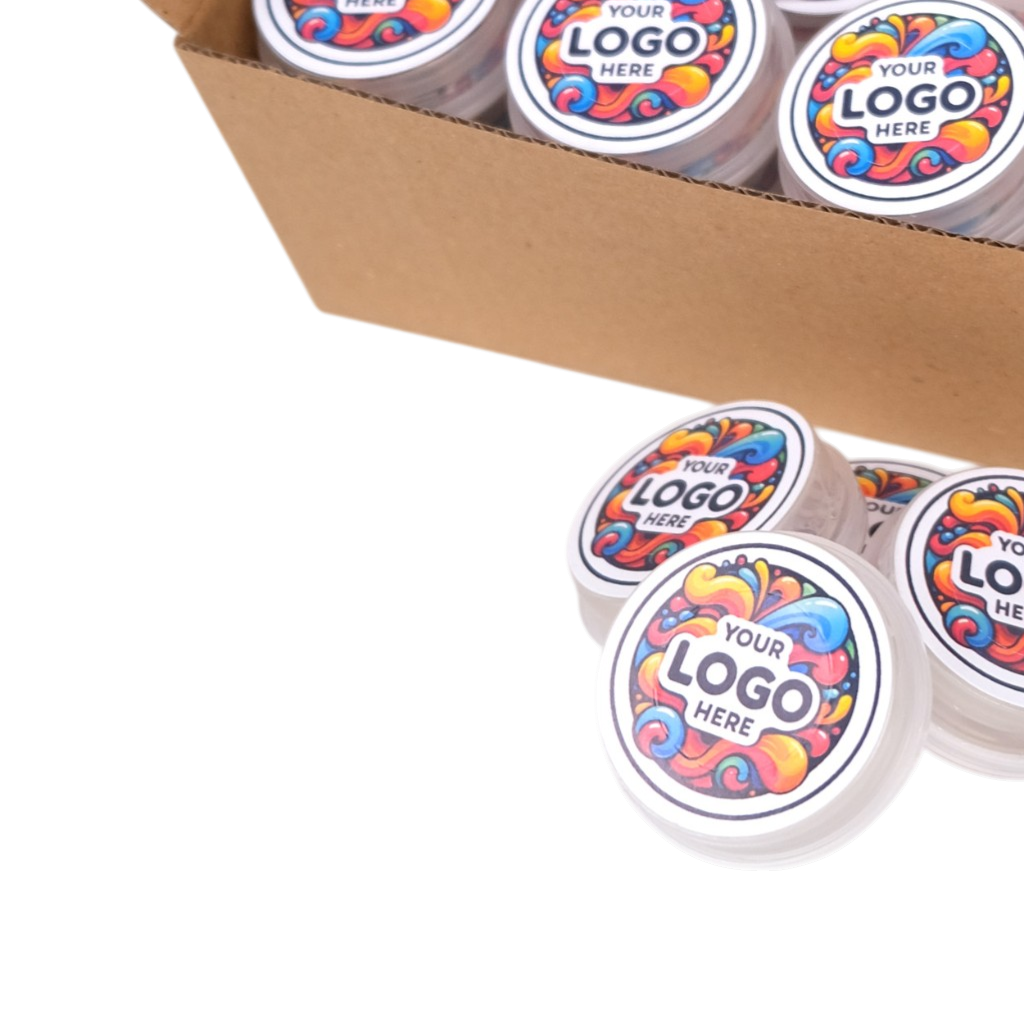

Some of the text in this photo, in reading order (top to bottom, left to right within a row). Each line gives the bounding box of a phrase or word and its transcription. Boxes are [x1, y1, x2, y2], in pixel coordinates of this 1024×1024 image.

[608, 4, 665, 18] YOUR
[568, 26, 701, 58] LOGO
[600, 62, 655, 77] HERE
[879, 61, 936, 77] YOUR
[841, 80, 976, 120] LOGO
[875, 120, 931, 137] HERE
[682, 459, 730, 476] YOUR
[629, 477, 744, 513] LOGO
[643, 512, 691, 529] HERE
[725, 621, 785, 660] YOUR
[667, 639, 813, 724] LOGO
[693, 700, 755, 737] HERE
